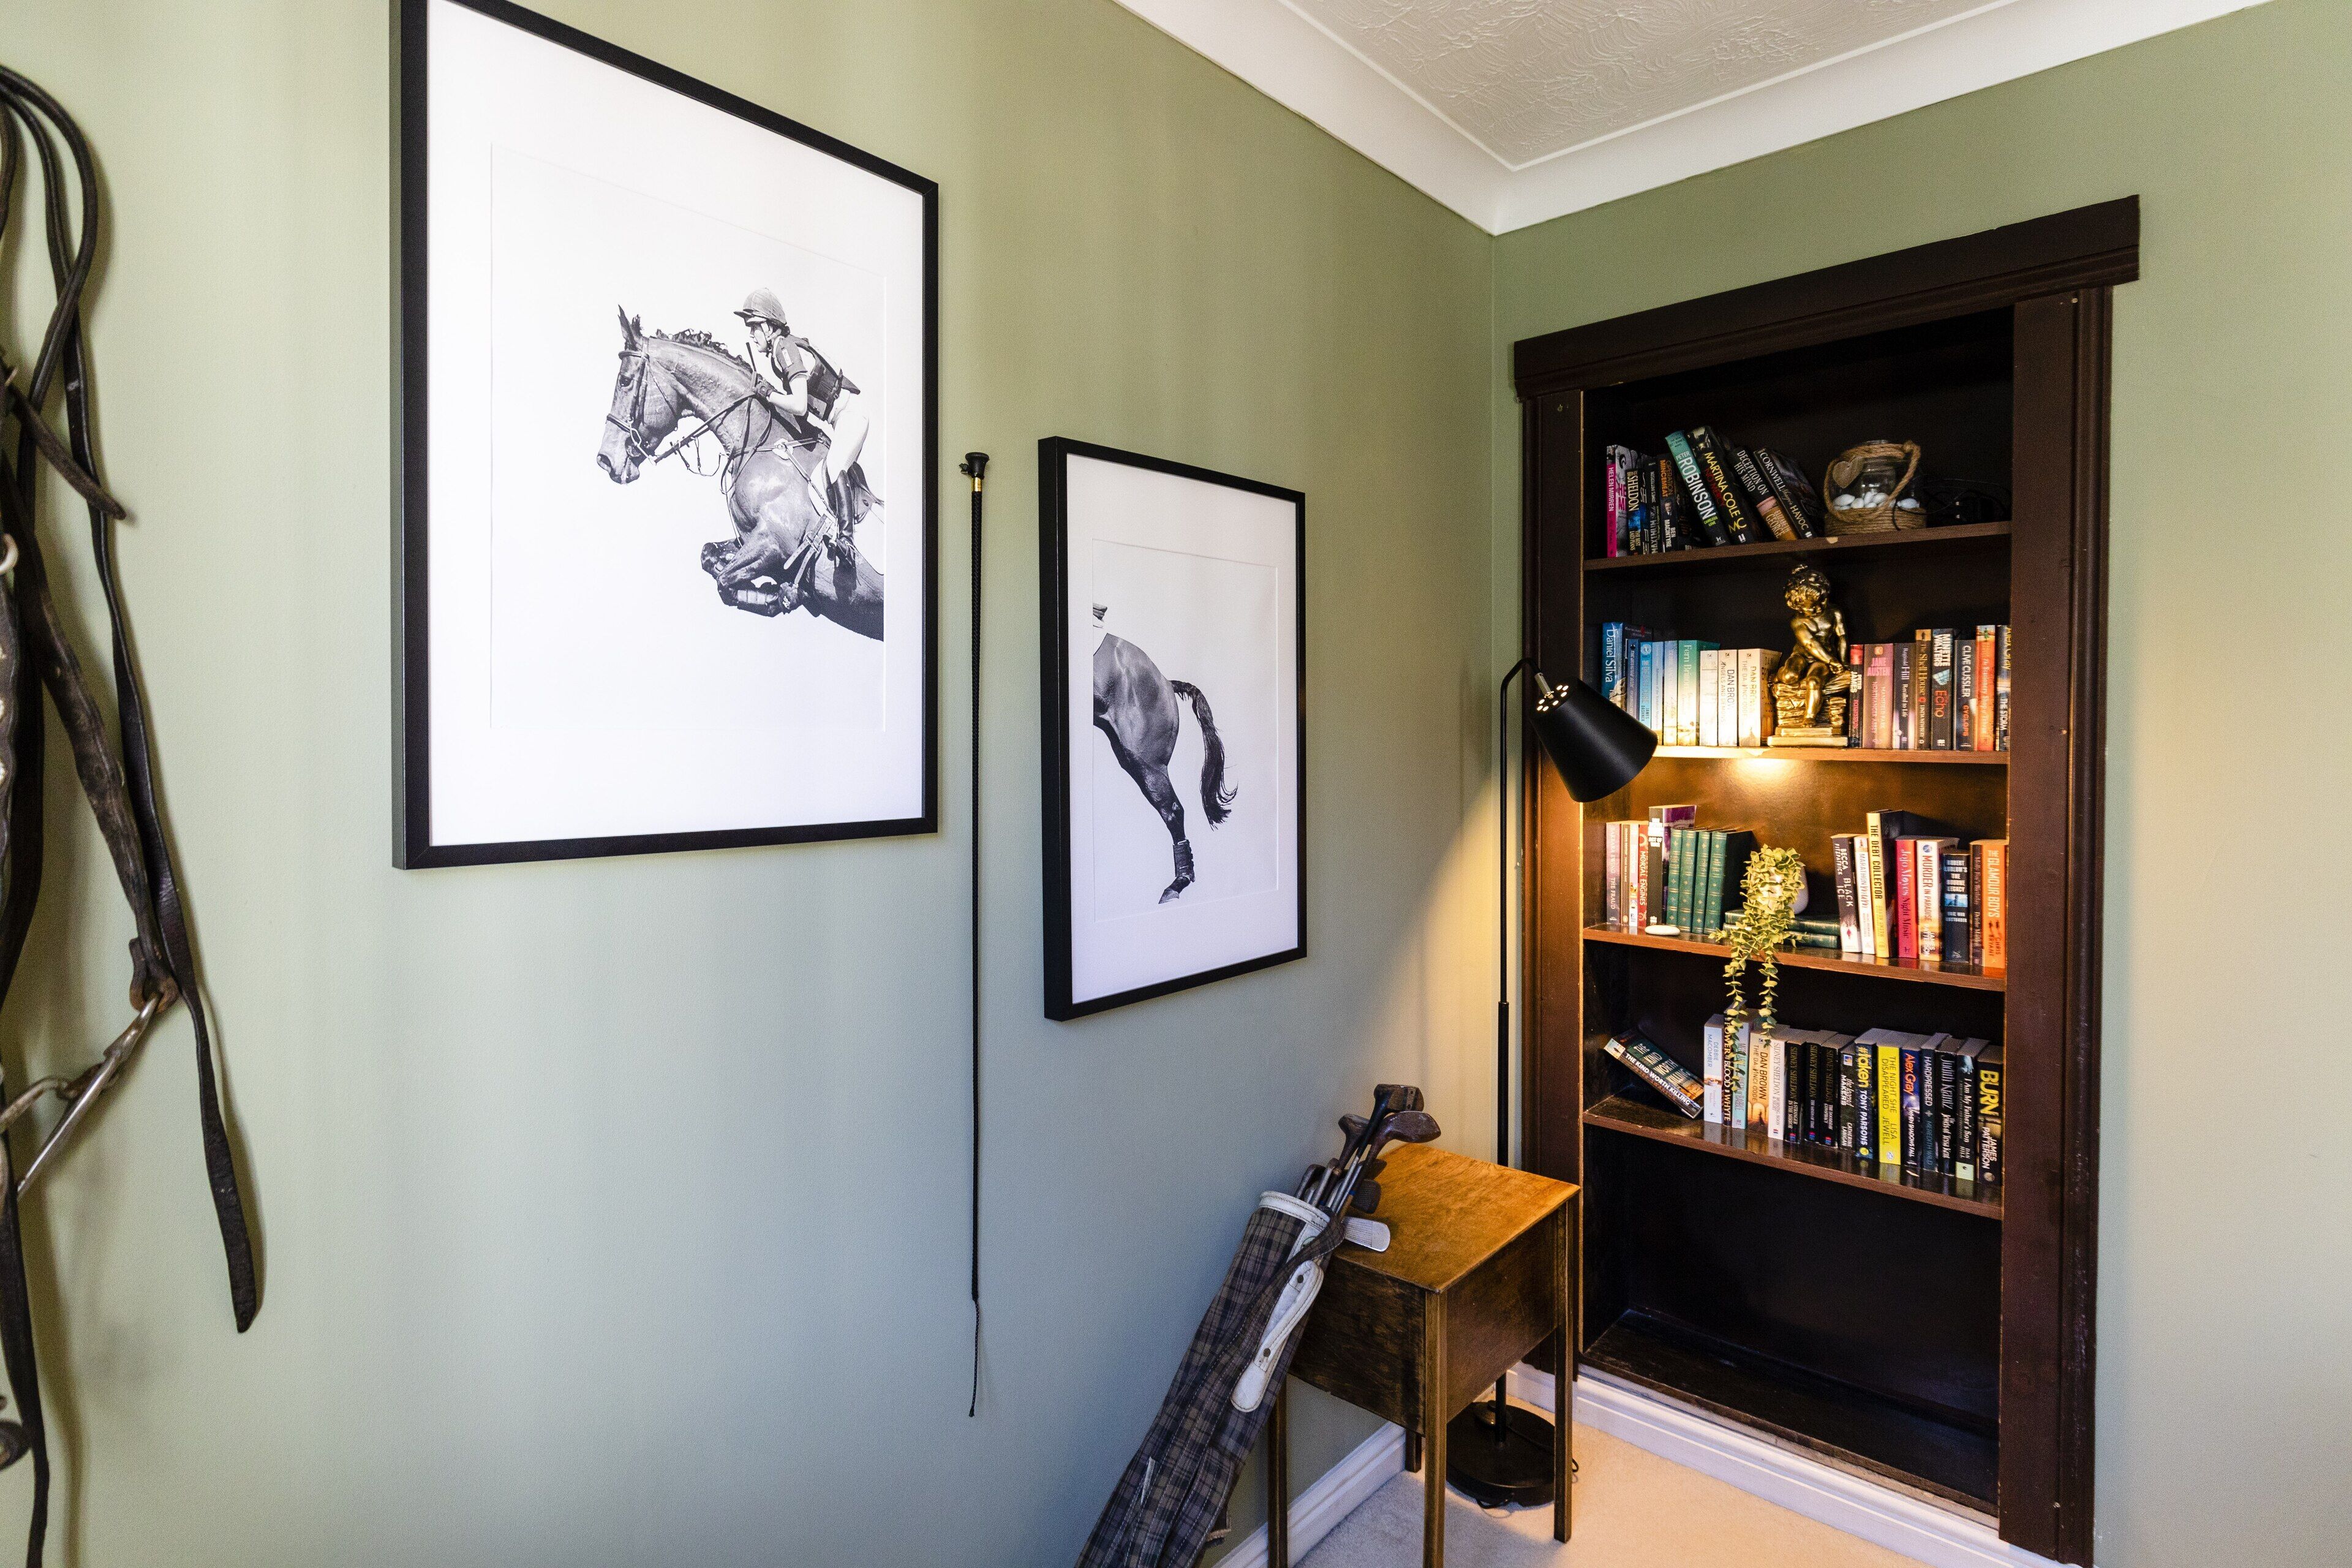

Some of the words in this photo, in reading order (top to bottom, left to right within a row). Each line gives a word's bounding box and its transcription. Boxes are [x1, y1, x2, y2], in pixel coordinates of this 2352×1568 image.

[1676, 451, 1690, 461] PETER
[1734, 464, 1746, 475] HIS
[1741, 474, 1756, 492] MIND
[1736, 450, 1762, 485] DECEPTION
[1758, 484, 1769, 496] ON
[1759, 452, 1785, 492] CORNWELL
[1627, 476, 1639, 511] SHELDON
[1677, 457, 1716, 520] ROBINSON
[1705, 452, 1728, 493] MARTINA
[1723, 492, 1741, 518] COLE
[1765, 514, 1785, 538] GEORGE
[1774, 510, 1792, 532] ELIZABETH
[1790, 505, 1809, 530] HAVOC
[1607, 629, 1616, 657] Daniel
[1934, 635, 1942, 666] WALTERS
[1942, 633, 1951, 666] MINETTE
[1962, 646, 1971, 665] CLIVE
[1605, 660, 1615, 682] Silva
[1868, 667, 1890, 676] AUSTEN
[1871, 657, 1887, 666] JANE
[1901, 667, 1910, 680] Hill
[1919, 654, 1928, 671] Shell
[1962, 666, 1971, 697] CUSSLER
[1934, 690, 1947, 718] Echo
[1870, 824, 1879, 837] THE
[1899, 850, 1911, 867] Jojo
[1873, 861, 1883, 899] COLLECTOR
[1899, 869, 1911, 895] Moyes
[1922, 856, 1933, 888] MURDER
[1988, 858, 2000, 895] GLAMOUR
[1844, 878, 1853, 907] BLACK
[1901, 897, 1910, 916] Night
[1988, 897, 2000, 918] BOYS
[1902, 919, 1911, 938] Music
[1632, 1043, 1649, 1054] THE
[1643, 1051, 1663, 1065] KIND
[1858, 1047, 1872, 1088] #taken
[1905, 1054, 1915, 1072] Alex
[1940, 1055, 1954, 1081] Judith
[1625, 1053, 1637, 1064] THE
[1635, 1060, 1651, 1076] KIND
[1649, 1071, 1672, 1091] WORTH
[1668, 1086, 1691, 1106] KILLING
[1903, 1074, 1916, 1095] Gray
[1924, 1057, 1932, 1106] HARDPRESSED
[1964, 1082, 1972, 1094] Am
[1940, 1084, 1954, 1109] Krantz
[1962, 1095, 1972, 1105] My
[1979, 1070, 1999, 1117] BURN
[1940, 1113, 1951, 1128] Jewels
[1963, 1106, 1972, 1129] Father's
[1943, 1148, 1951, 1159] Kent
[1981, 1126, 1990, 1169] PATTERSON
